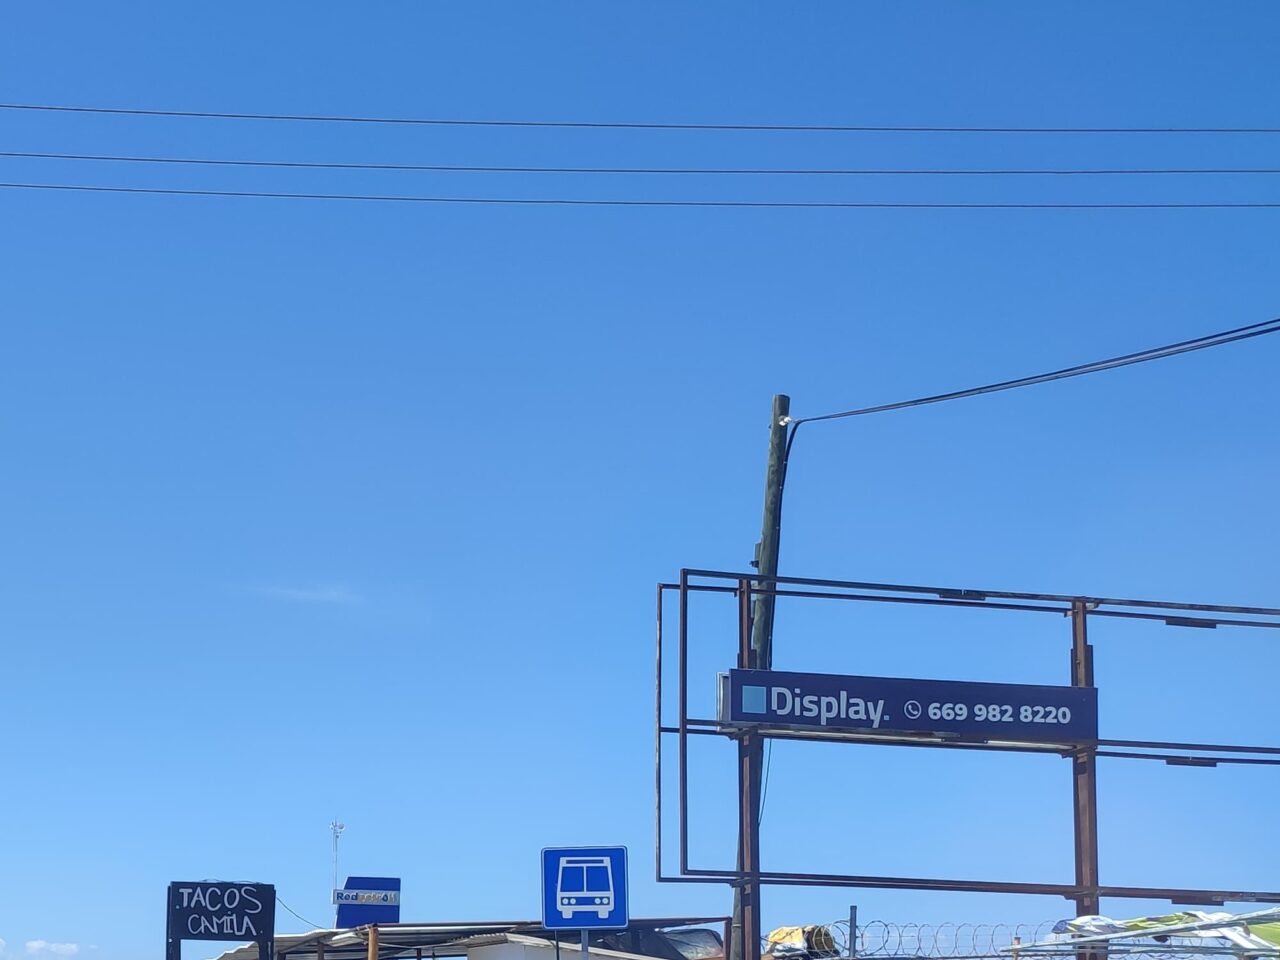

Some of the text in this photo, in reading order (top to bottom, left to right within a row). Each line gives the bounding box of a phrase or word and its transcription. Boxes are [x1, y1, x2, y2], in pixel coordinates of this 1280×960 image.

[927, 702, 968, 721] 669
[974, 704, 1014, 723] 982
[1019, 705, 1072, 725] 8220
[179, 886, 262, 914] TACOS
[188, 914, 257, 936] CAMILA
